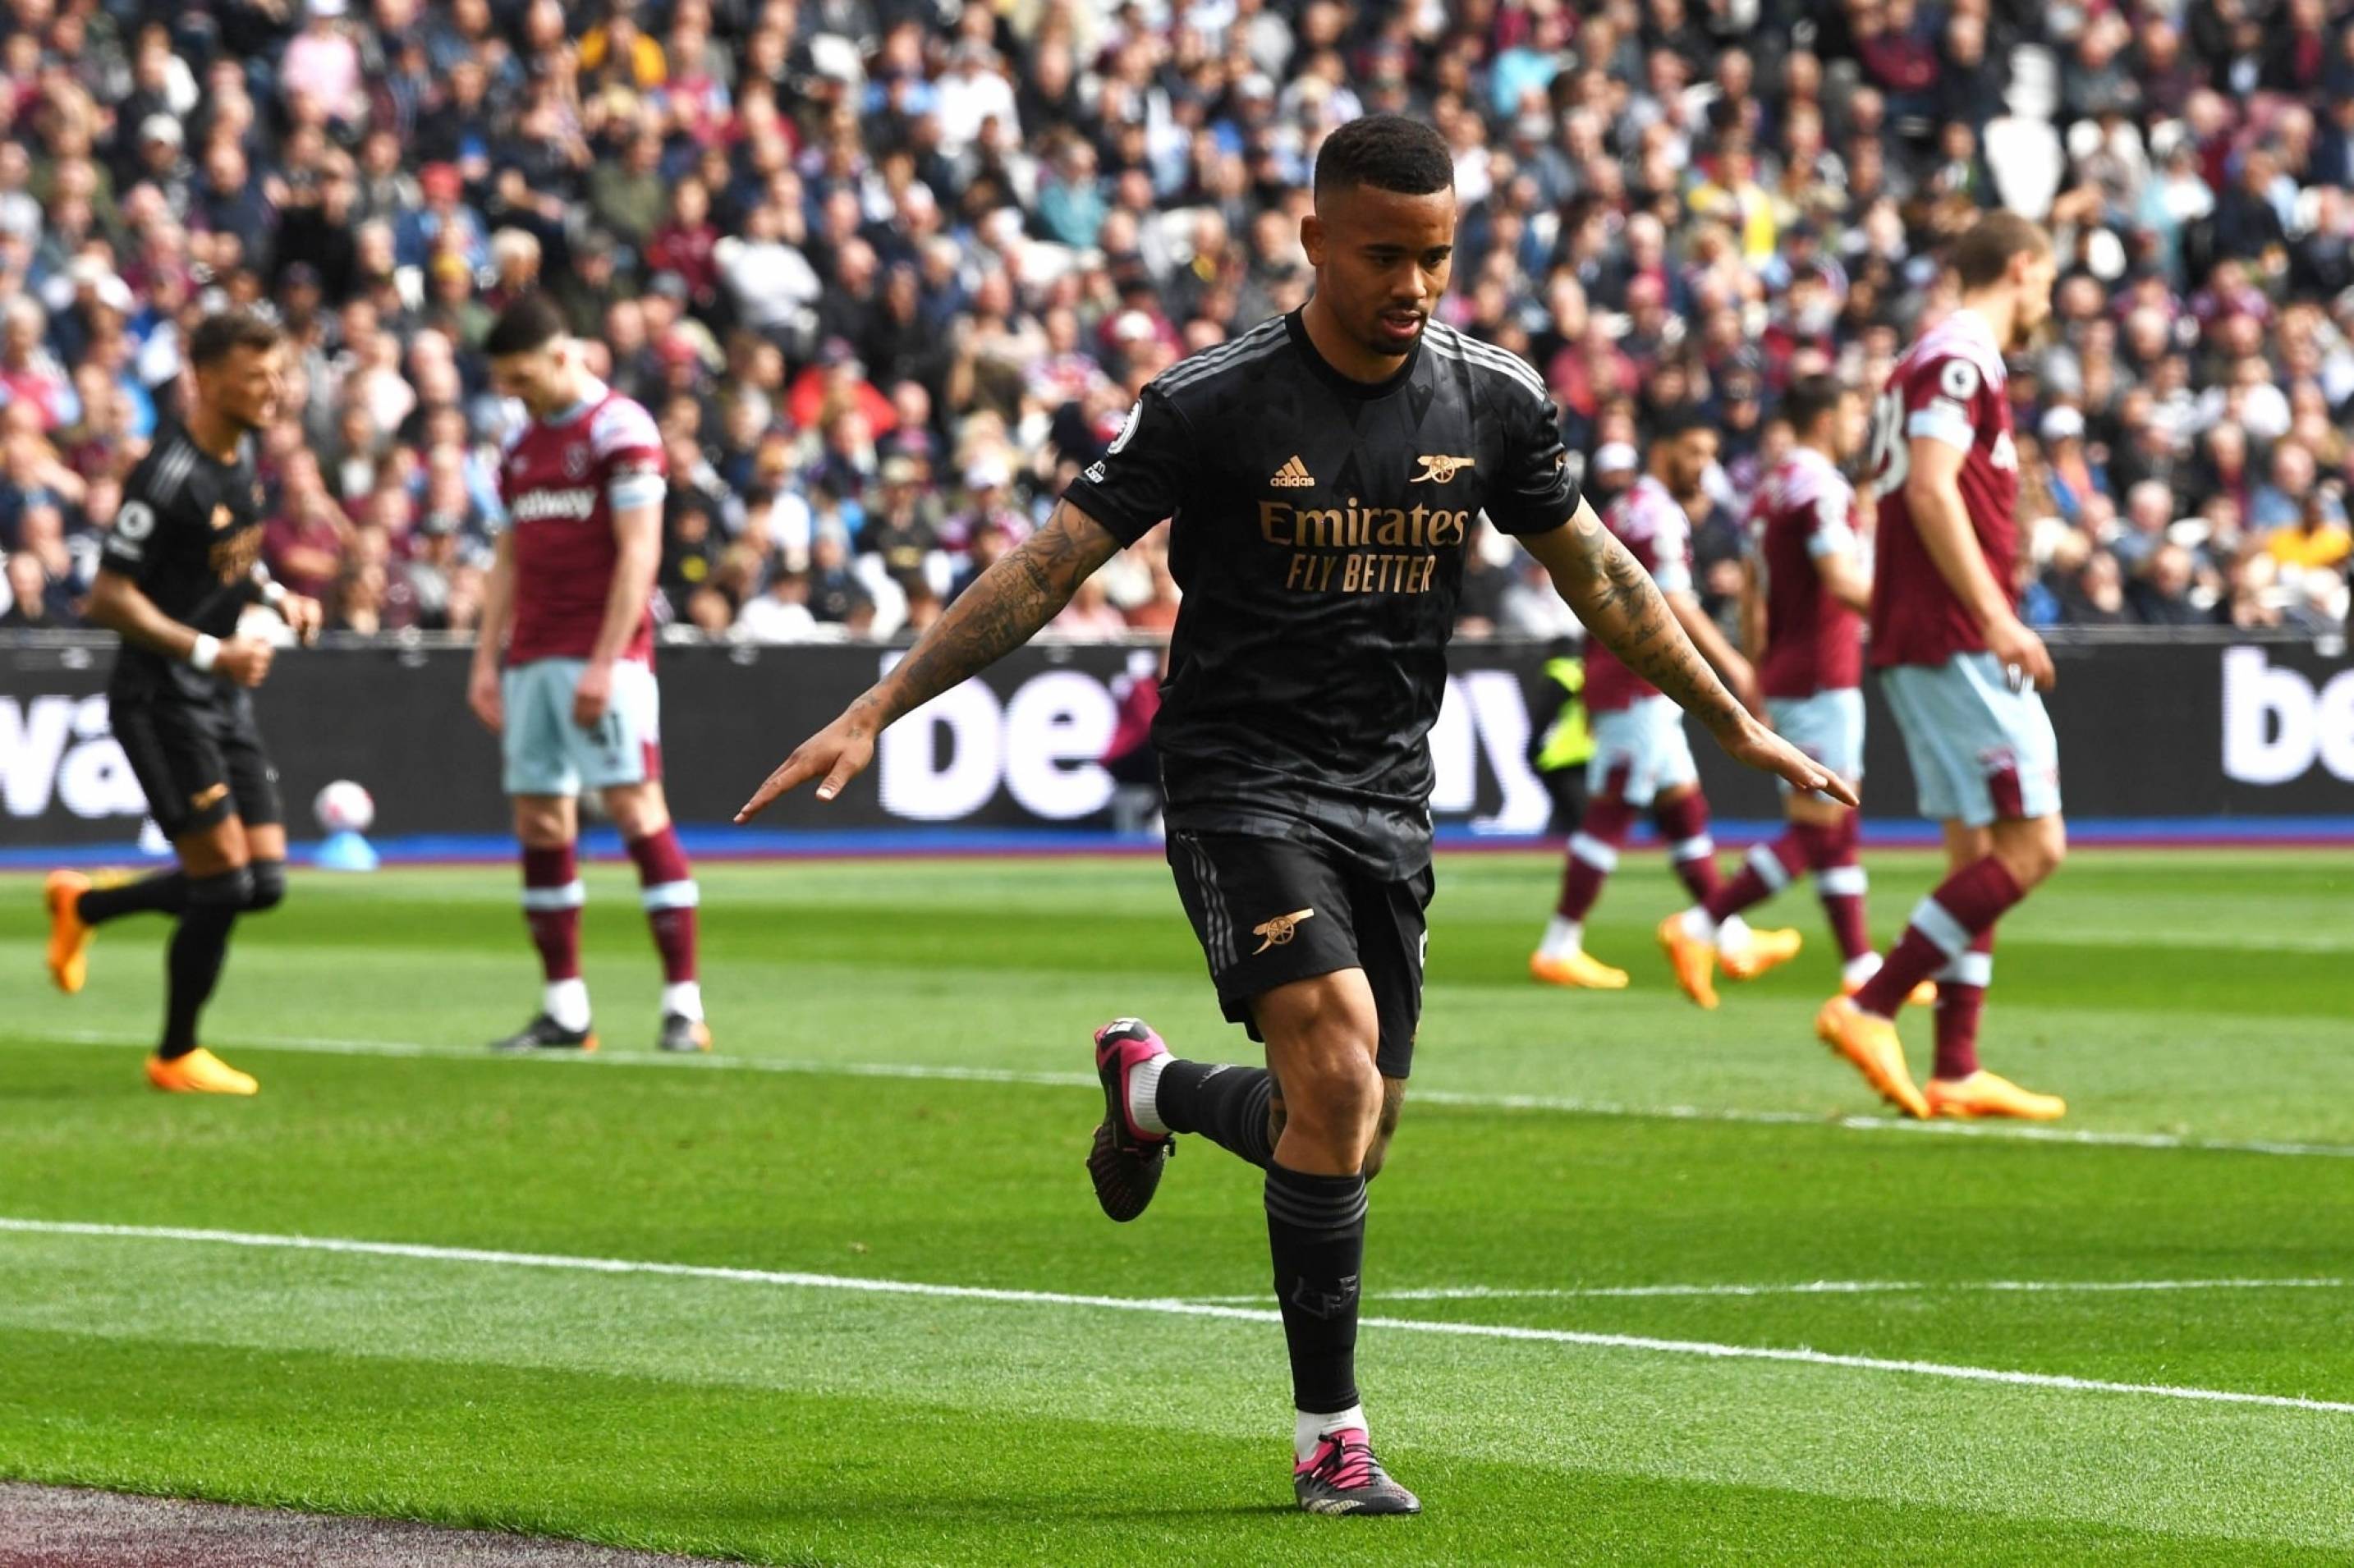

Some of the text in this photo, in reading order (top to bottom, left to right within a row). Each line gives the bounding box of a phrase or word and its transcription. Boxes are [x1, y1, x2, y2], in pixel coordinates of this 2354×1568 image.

[1269, 475, 1315, 487] adidas
[1257, 497, 1469, 548] Emirates
[1286, 552, 1436, 594] FLY BETTER
